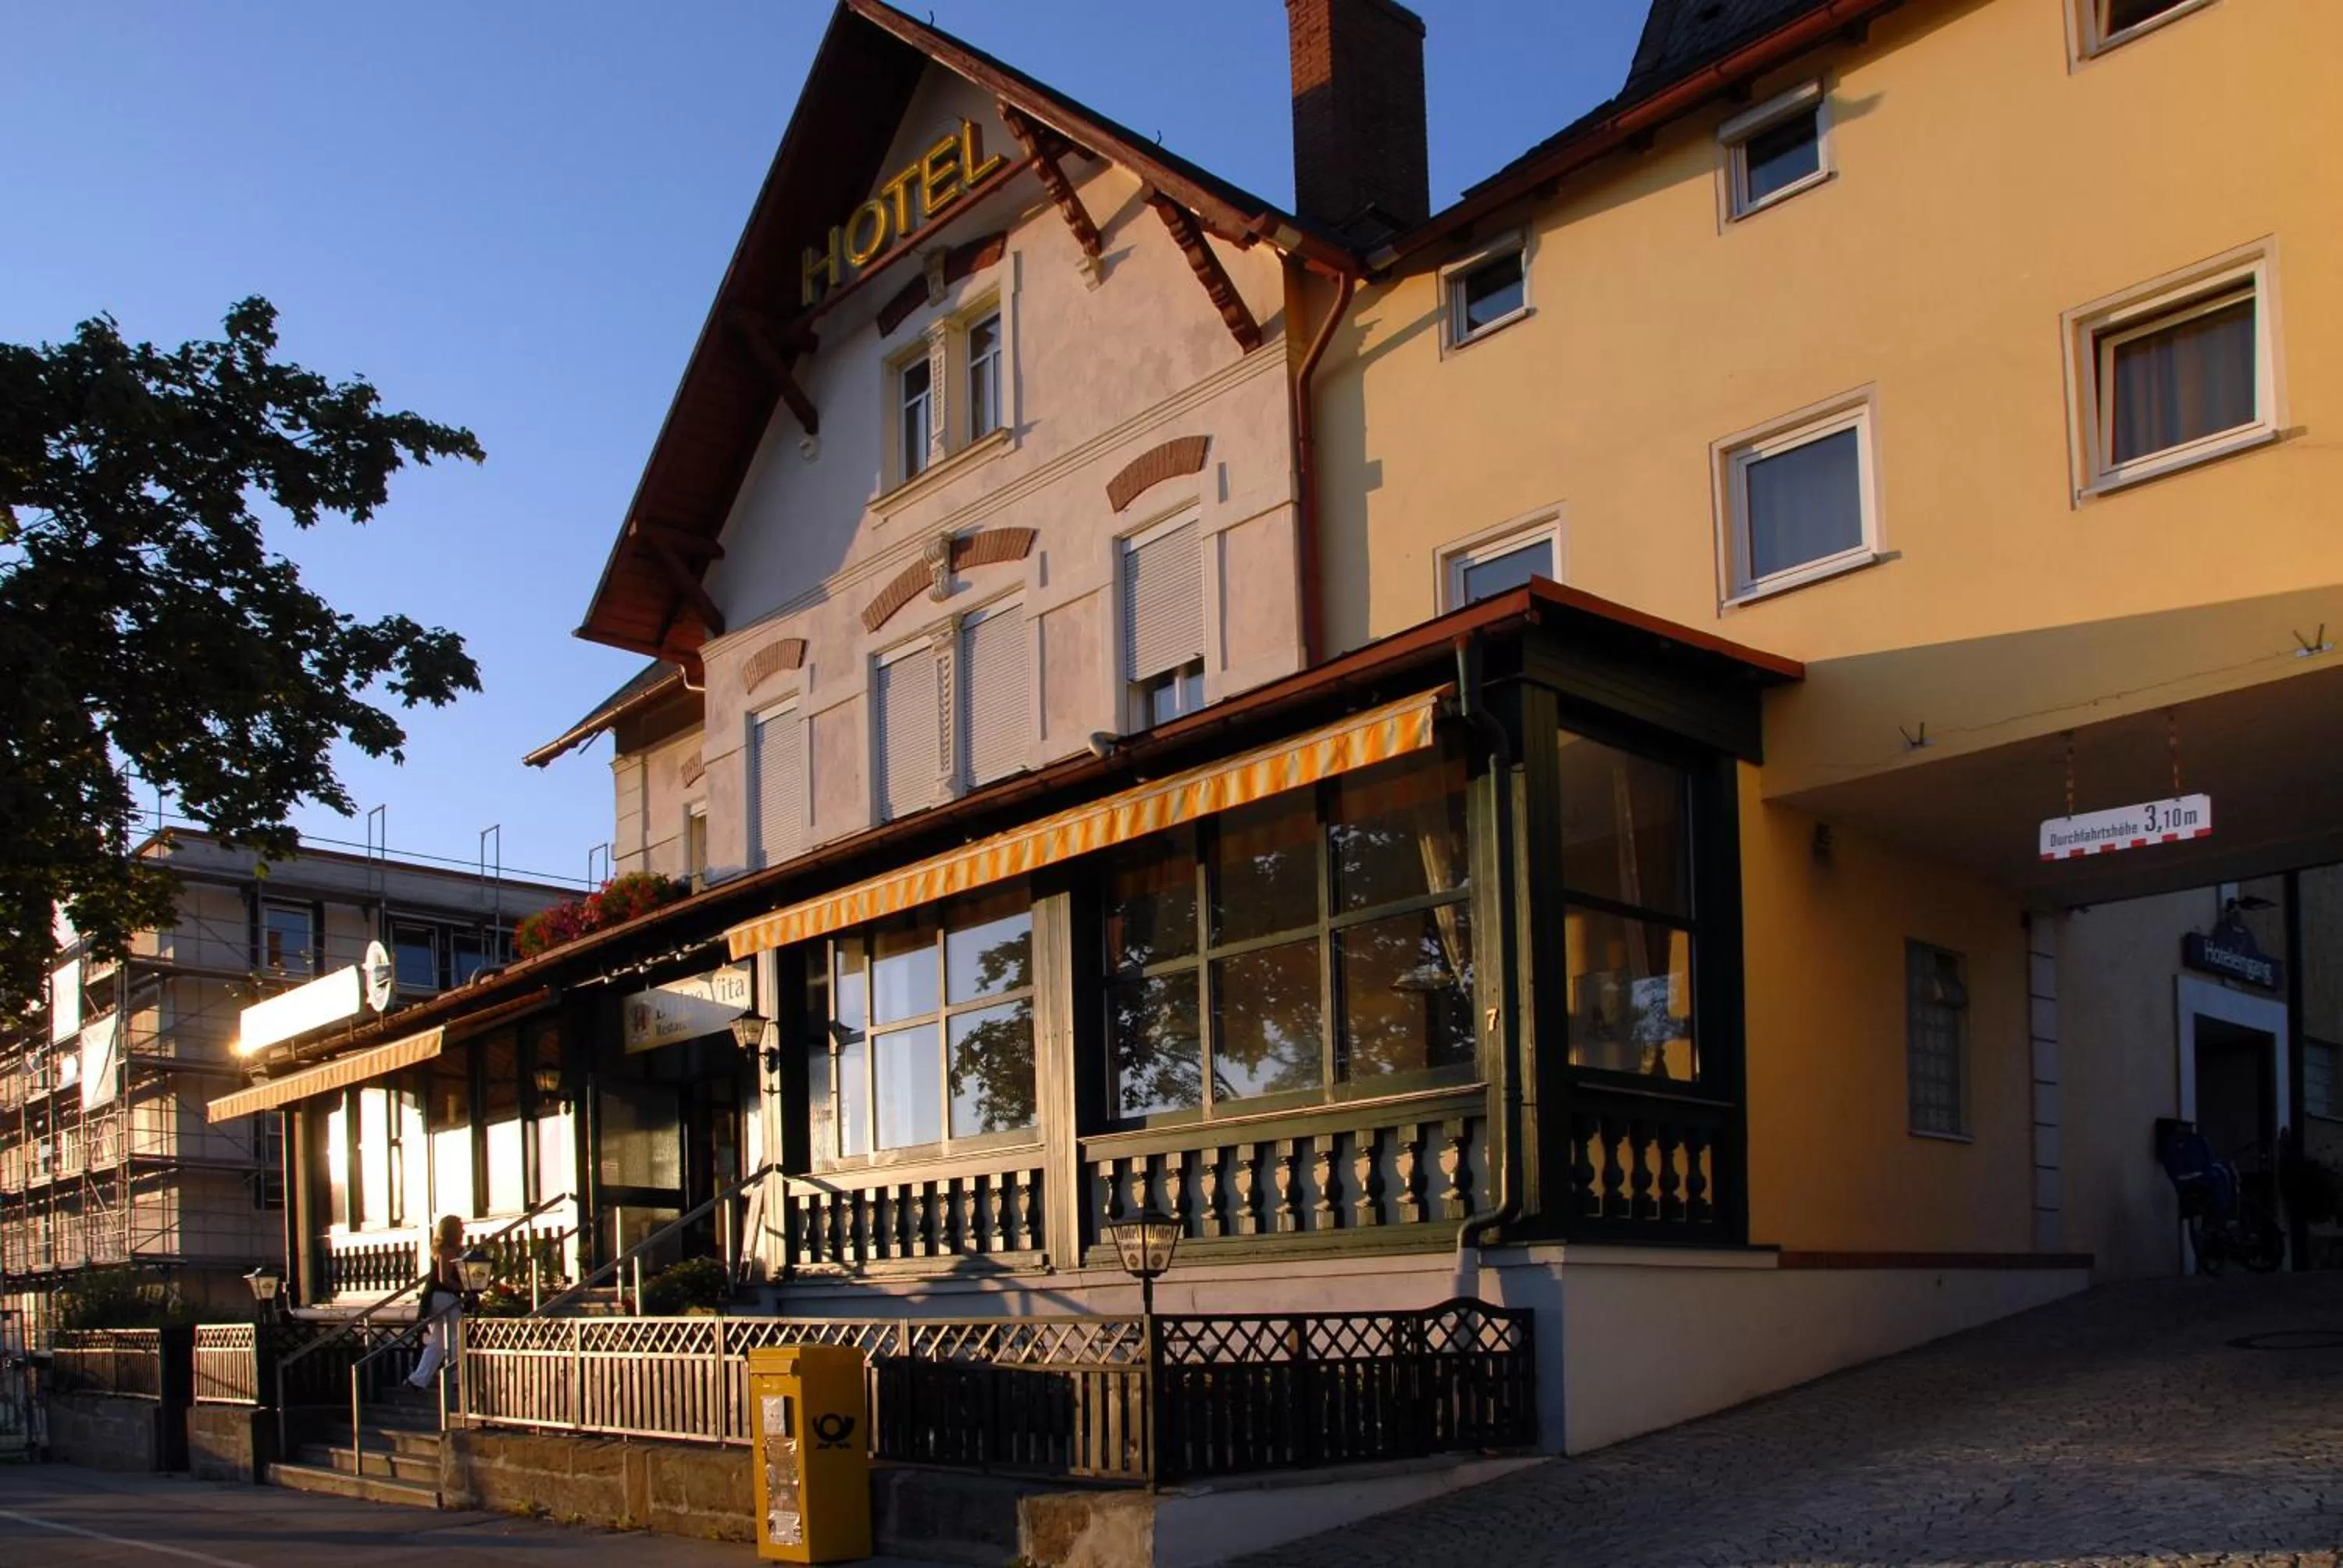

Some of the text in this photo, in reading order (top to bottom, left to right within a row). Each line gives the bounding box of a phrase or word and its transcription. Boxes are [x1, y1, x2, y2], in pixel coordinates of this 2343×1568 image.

[800, 118, 1003, 307] HOTEL
[2049, 822, 2138, 848] Durchfahrtshöhe
[708, 976, 744, 1006] Vita
[1486, 1008, 1498, 1032] 7
